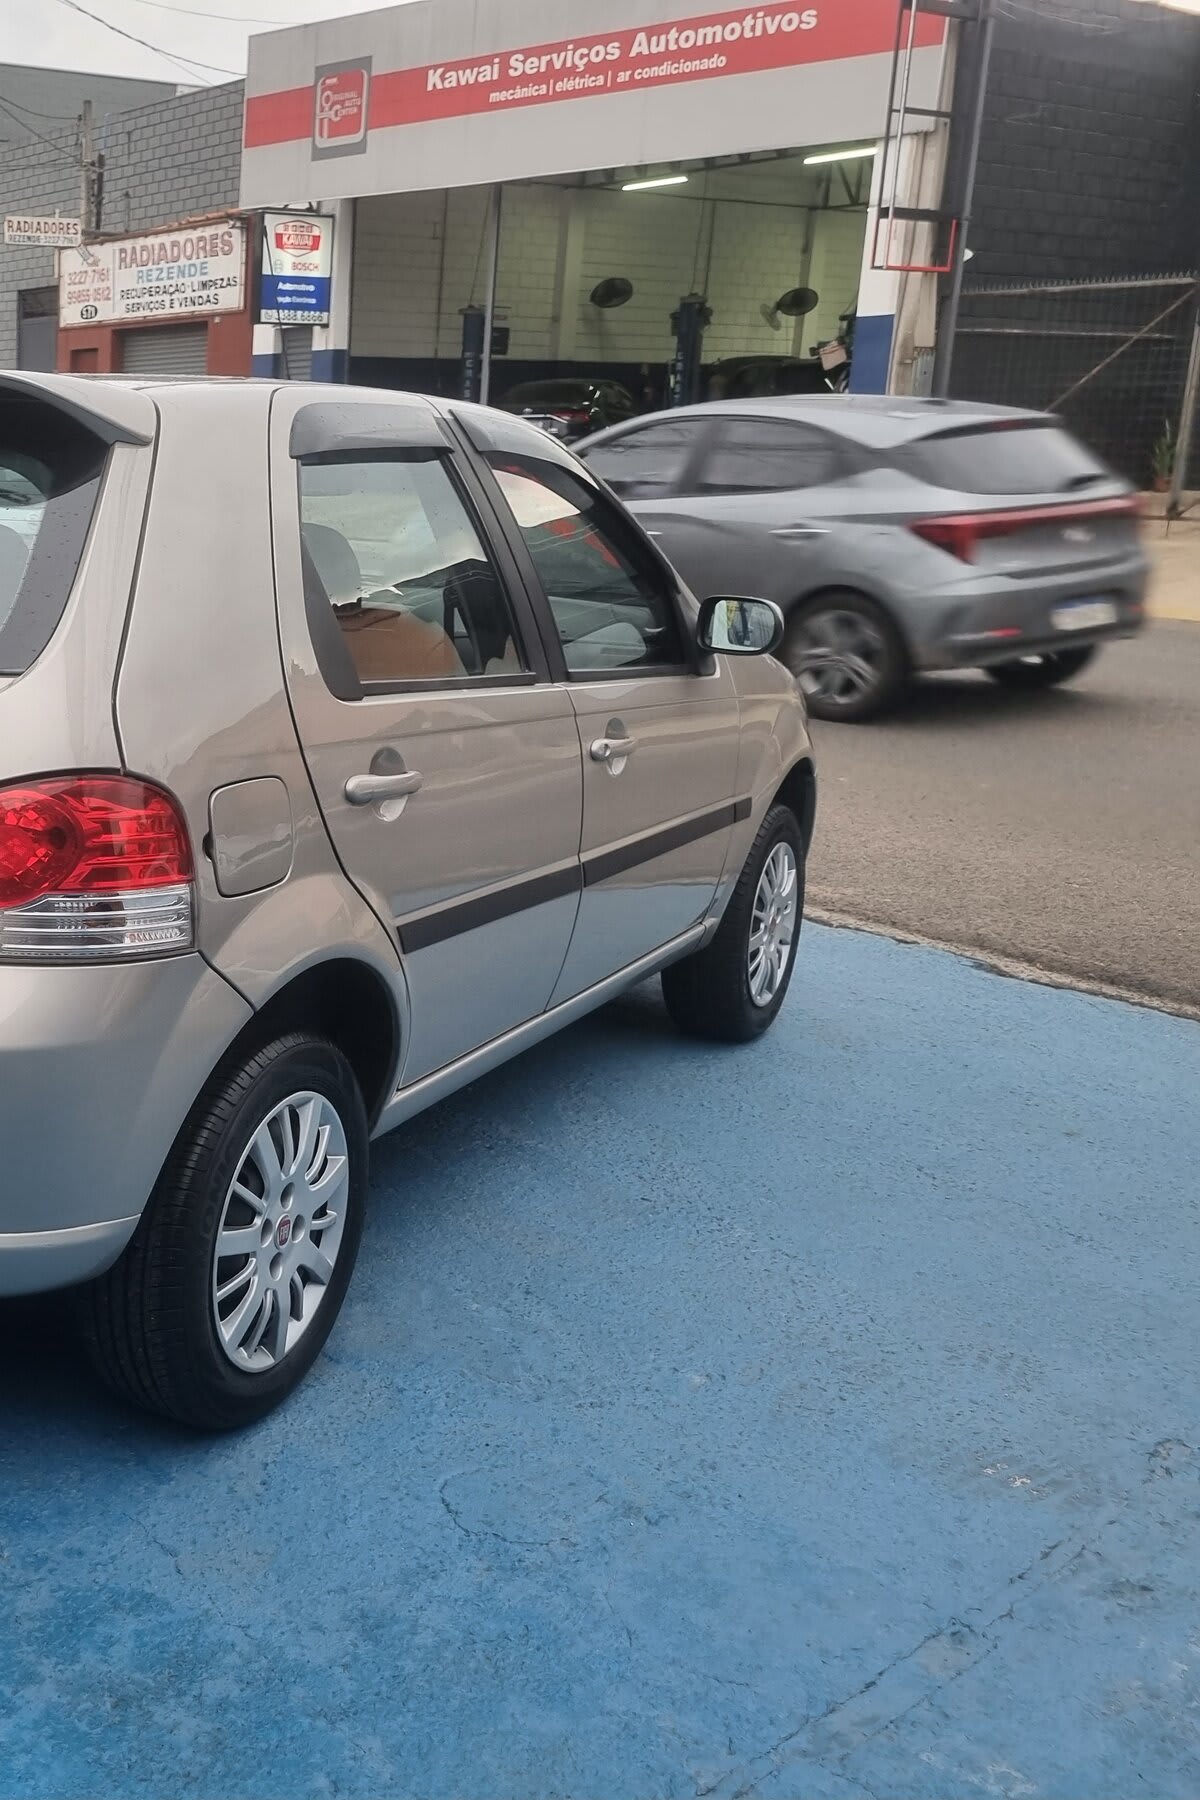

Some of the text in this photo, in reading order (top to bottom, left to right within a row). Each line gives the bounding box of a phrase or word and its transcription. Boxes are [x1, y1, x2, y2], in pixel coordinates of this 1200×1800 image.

[426, 8, 818, 91] Kawai Serviços Automotivos
[555, 71, 604, 93] elétrica
[616, 68, 632, 83] ar
[634, 54, 727, 80] condicionado
[7, 219, 79, 235] RADIADORES
[118, 230, 234, 270] RADIADORES
[282, 234, 313, 247] KAWAI
[136, 261, 209, 284] REZENDE
[291, 261, 319, 272] BOSCH
[190, 276, 238, 293] LIMPEZAS
[124, 293, 219, 314] SERVIÇOS E VENDAS
